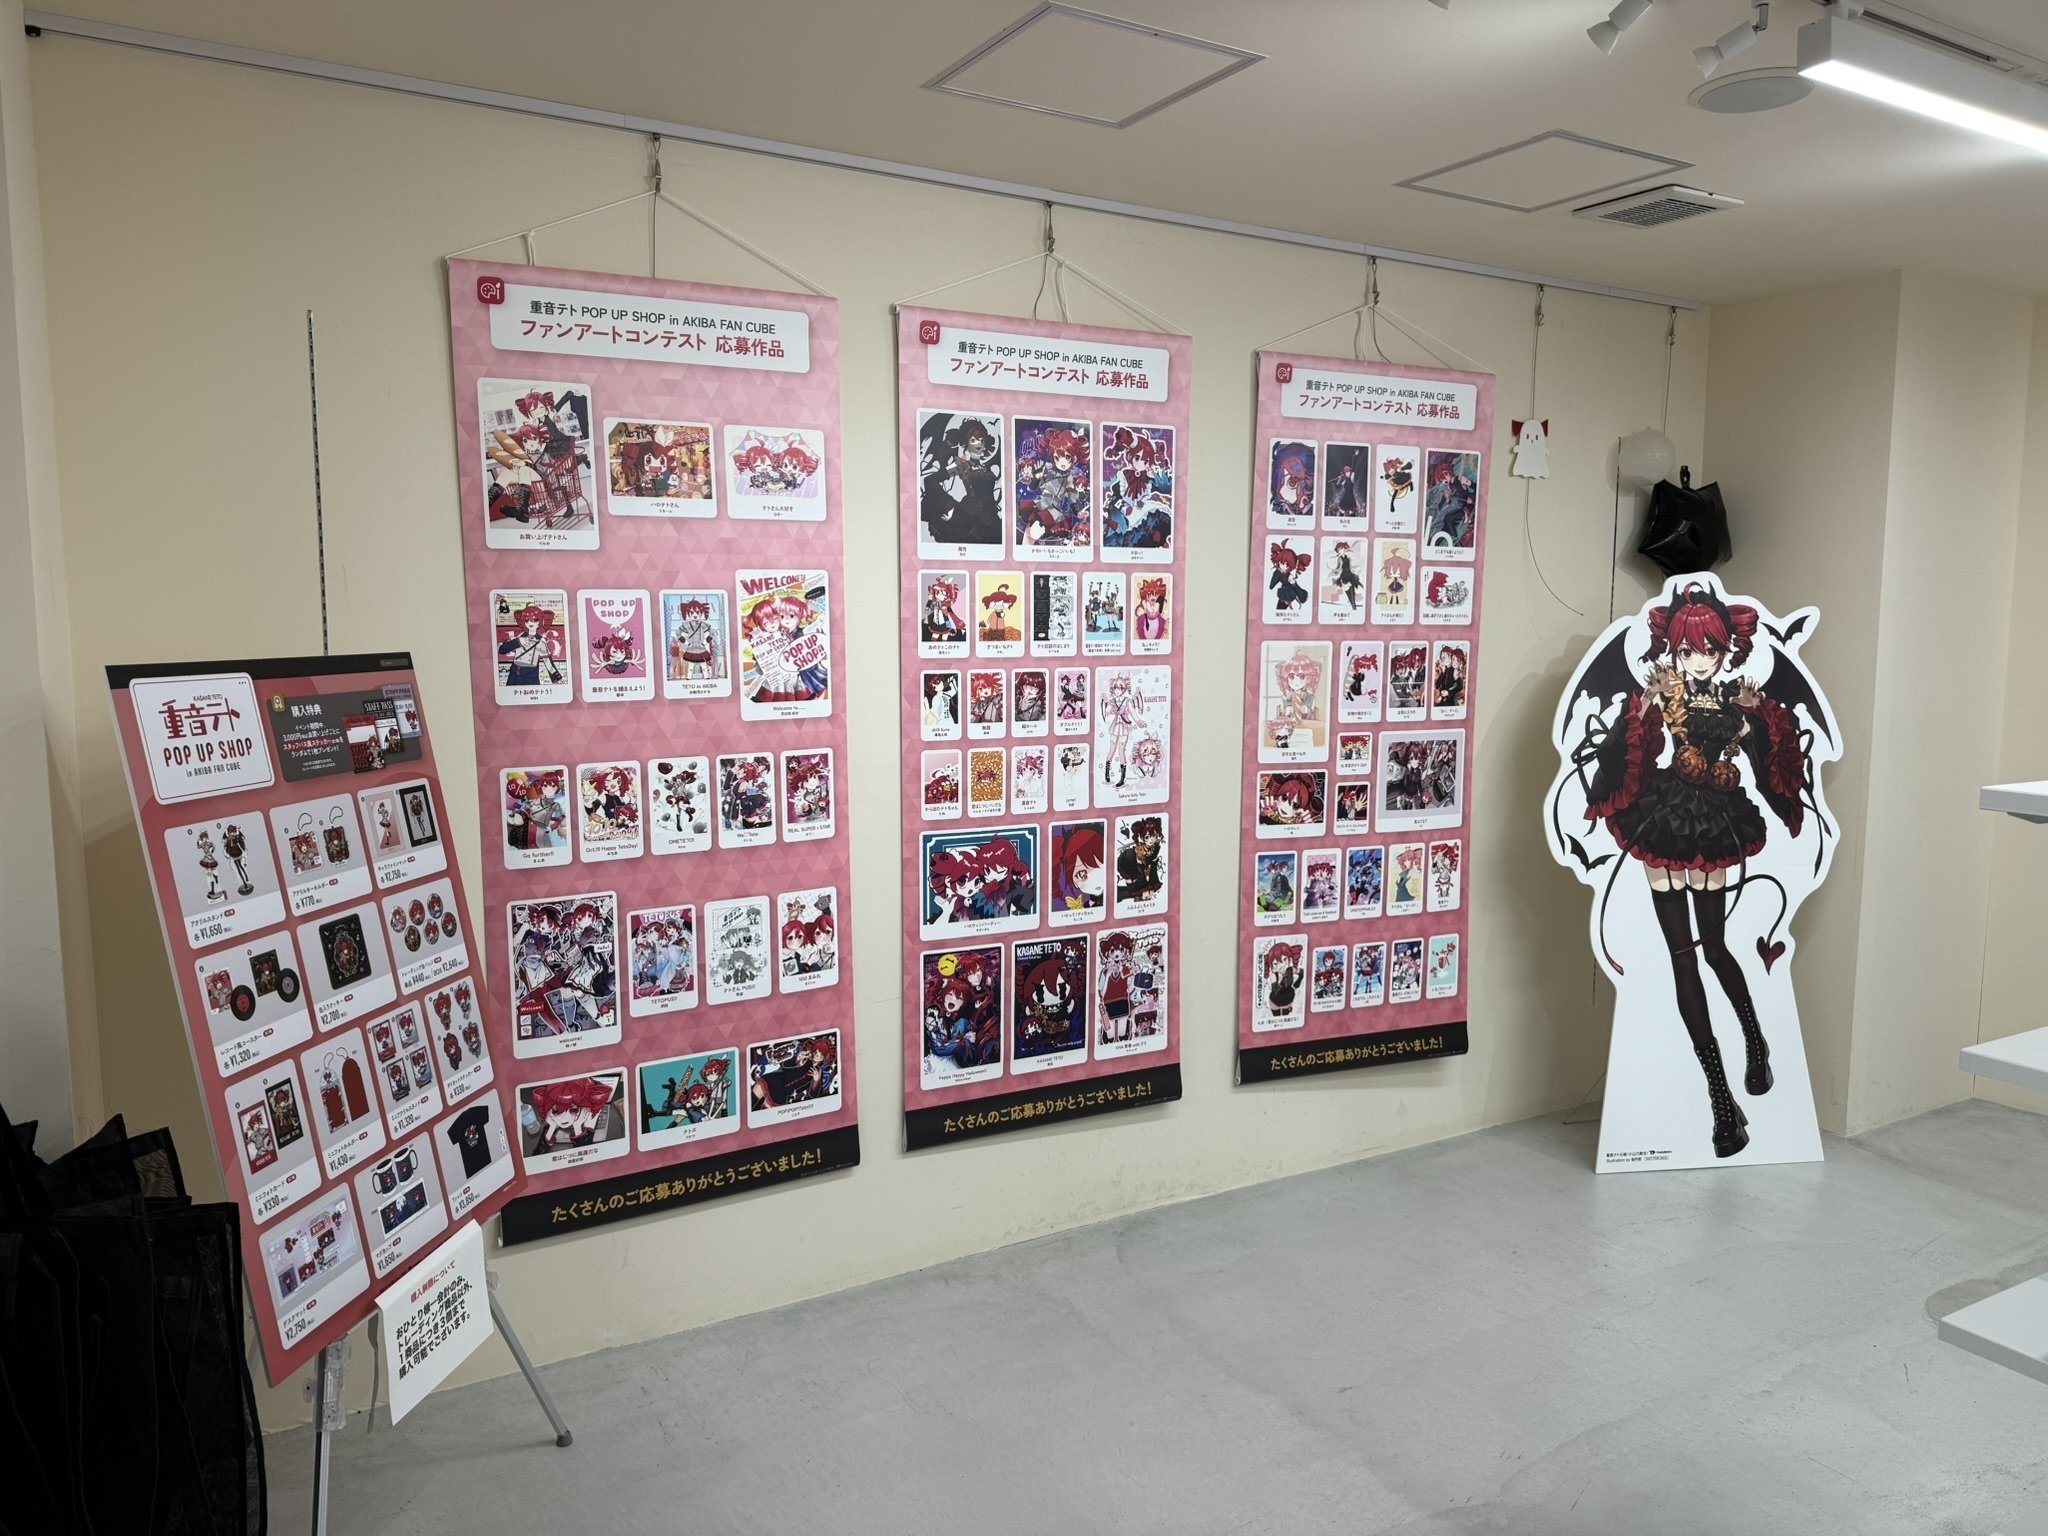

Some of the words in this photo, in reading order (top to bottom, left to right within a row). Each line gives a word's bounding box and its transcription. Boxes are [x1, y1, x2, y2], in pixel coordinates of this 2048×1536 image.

[530, 300, 577, 316] 重音テト
[581, 306, 608, 318] POP
[611, 309, 628, 321] UP
[632, 311, 666, 324] SHOP
[669, 315, 679, 325] in
[682, 316, 716, 328] AKIBA
[720, 319, 742, 331] FAN
[746, 322, 776, 334] CUBE
[521, 320, 707, 351] ファンアートコンテスト
[715, 335, 785, 358] 応募作品
[958, 341, 994, 355] 重音テト
[996, 346, 1016, 357] POP
[1018, 348, 1032, 358] UP
[1034, 350, 1060, 361] SHOP
[1062, 353, 1070, 362] in
[1072, 354, 1098, 365] AKIBA
[1100, 356, 1118, 367] FAN
[1120, 358, 1144, 369] CUBE
[951, 358, 1089, 384] ファンアートコンテスト
[1096, 370, 1149, 389] 応募作品
[1306, 380, 1334, 391] 重音テト
[1336, 383, 1353, 393] POP
[1354, 385, 1366, 394] UP
[1367, 386, 1388, 396] SHOP
[1397, 389, 1419, 399] AKIBA
[1420, 391, 1435, 400] FAN
[1436, 392, 1456, 402] CUBE
[1300, 394, 1412, 416] ファンアートコンテスト
[1416, 403, 1460, 419] 応募作品
[593, 599, 615, 607] POP
[600, 610, 630, 618] SHOP
[784, 644, 804, 663] POP
[805, 634, 819, 650] UP
[158, 697, 240, 740] 重音テト
[290, 704, 323, 718] 購入特典
[163, 745, 191, 768] POP
[196, 742, 214, 763] UP
[218, 737, 253, 760] SHOP
[186, 769, 193, 778] in
[194, 767, 213, 776] AKIBA
[214, 764, 225, 773] FAN
[226, 762, 241, 771] CUBE
[385, 869, 401, 883] ¥2,750
[300, 895, 315, 909] ¥770
[200, 923, 223, 940] ¥1,650
[1016, 944, 1043, 957] KASANE
[1043, 942, 1062, 953] TETO
[412, 972, 425, 986] ¥440
[442, 958, 458, 973] ¥2,640
[321, 1009, 341, 1026] ¥2,700
[229, 1049, 252, 1067] ¥1,320
[1270, 1036, 1443, 1071] たくさんのご応募ありがとうございました!
[943, 1081, 1153, 1133] たくさんのご応募ありがとうございました!
[397, 1113, 415, 1130] ¥1,320
[328, 1153, 349, 1172] ¥1,430
[255, 1181, 286, 1202] ミニフォトカード
[551, 1148, 823, 1223] たくさんのご応募ありがとうございました!
[263, 1194, 281, 1213] ¥330
[377, 1253, 396, 1271] ¥1,650
[410, 1259, 455, 1305] 購入制限について
[396, 1275, 466, 1341] おひとり様一会計のみ、
[398, 1280, 473, 1353] トレーディング商品以外、
[284, 1318, 307, 1341] ¥2,750
[400, 1299, 465, 1365] 1商品につき3個まで
[398, 1312, 471, 1380] 購入可能でございます。
